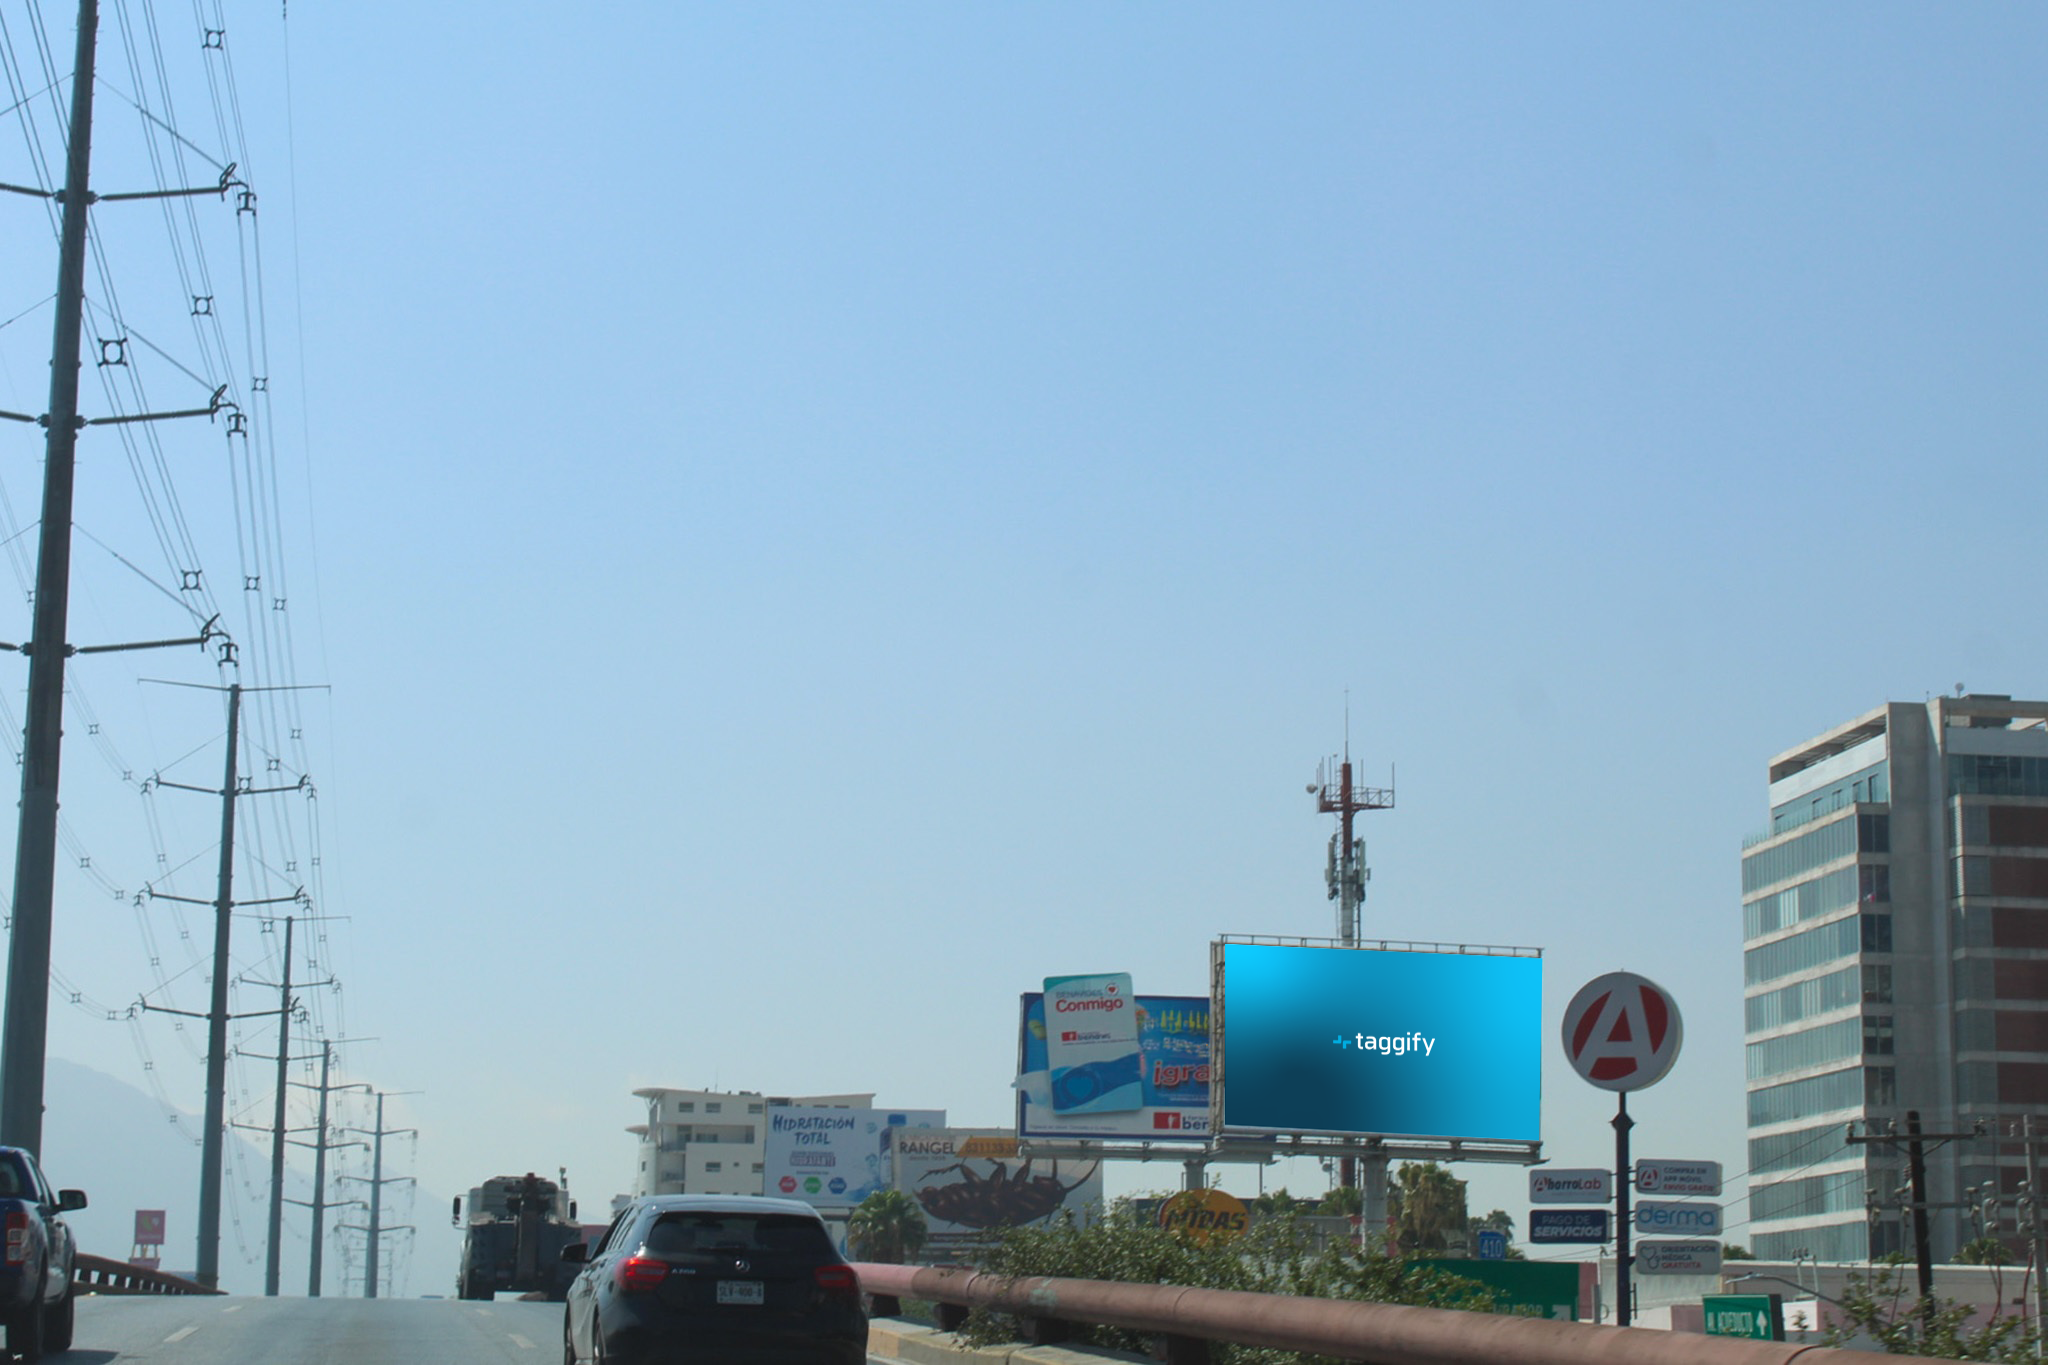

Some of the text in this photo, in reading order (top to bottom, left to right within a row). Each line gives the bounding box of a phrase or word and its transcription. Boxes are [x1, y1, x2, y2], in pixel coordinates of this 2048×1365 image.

[1056, 996, 1123, 1012] Conmigo
[1356, 1032, 1435, 1056] taggify
[773, 1114, 855, 1133] HIDRATACIÓN
[795, 1132, 832, 1145] TOTAL
[899, 1141, 957, 1154] RANGEL
[1663, 1167, 1695, 1175] COMPRA
[1688, 1184, 1714, 1192] GRATIS
[1166, 1208, 1245, 1231] MIDAS
[1542, 1214, 1591, 1225] PAGO DE
[1637, 1206, 1714, 1226] derma
[1534, 1226, 1602, 1237] SERVICIOS
[1482, 1240, 1501, 1257] 410
